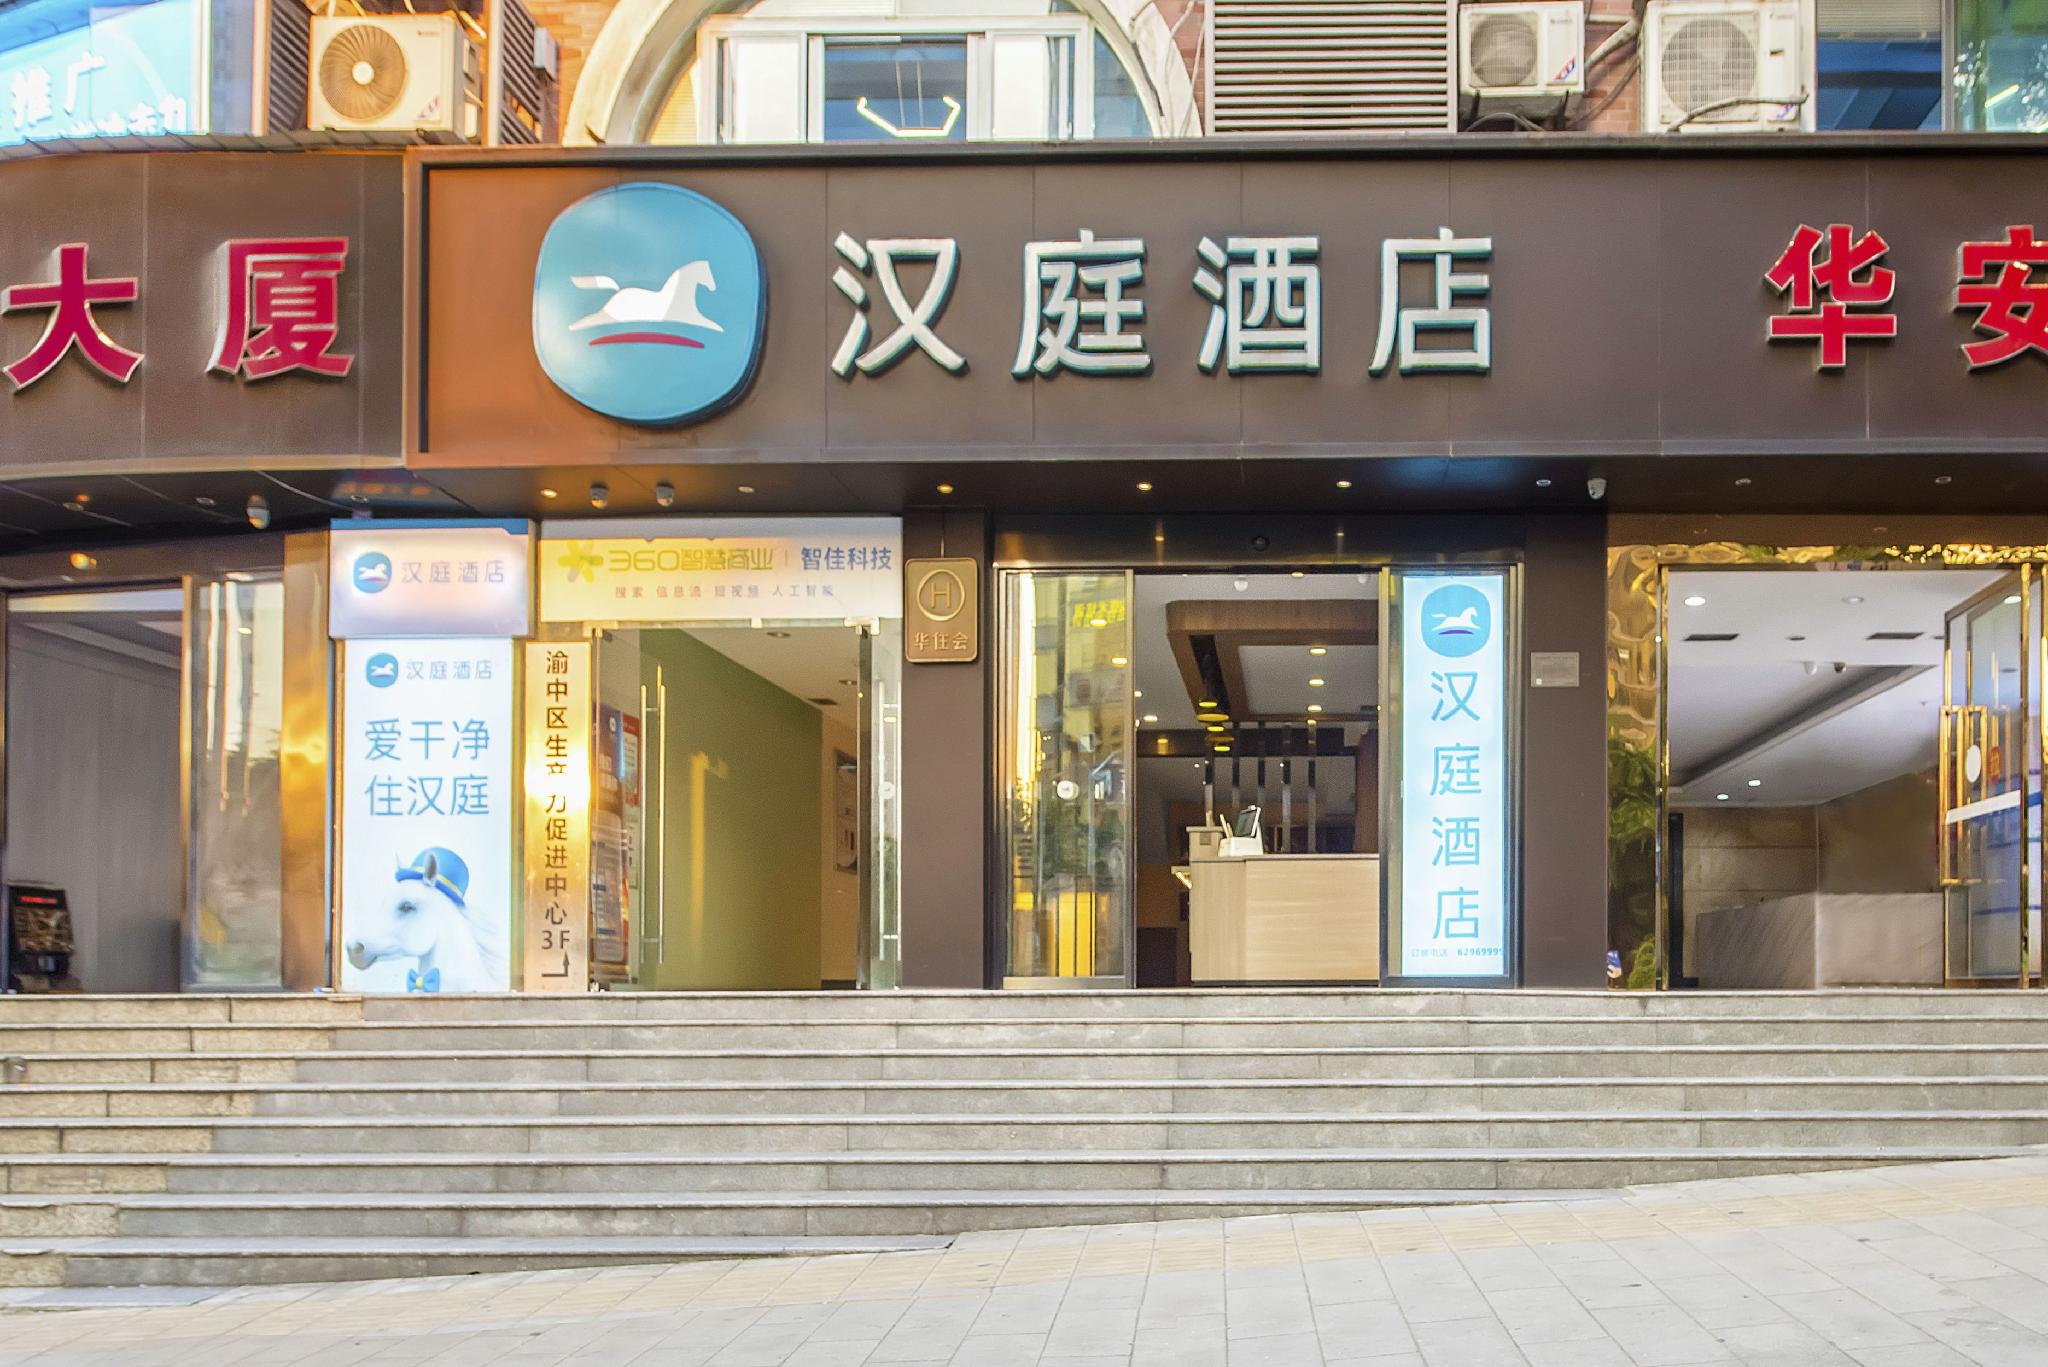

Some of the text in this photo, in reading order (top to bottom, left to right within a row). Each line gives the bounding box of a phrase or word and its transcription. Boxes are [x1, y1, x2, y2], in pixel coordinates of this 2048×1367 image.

[1, 236, 354, 390] 大厦
[832, 227, 1493, 377] 汉庭酒店
[1763, 223, 2048, 371] 华安
[401, 560, 506, 584] 汉庭酒店
[608, 546, 893, 572] 360智慧商业 智佳科技
[405, 660, 493, 681] 汉庭酒店
[364, 718, 490, 762] 爱干净
[545, 649, 569, 926] 渝中区生产力促进中心
[364, 773, 490, 817] 住汉庭
[1428, 669, 1483, 941] 汉庭酒店
